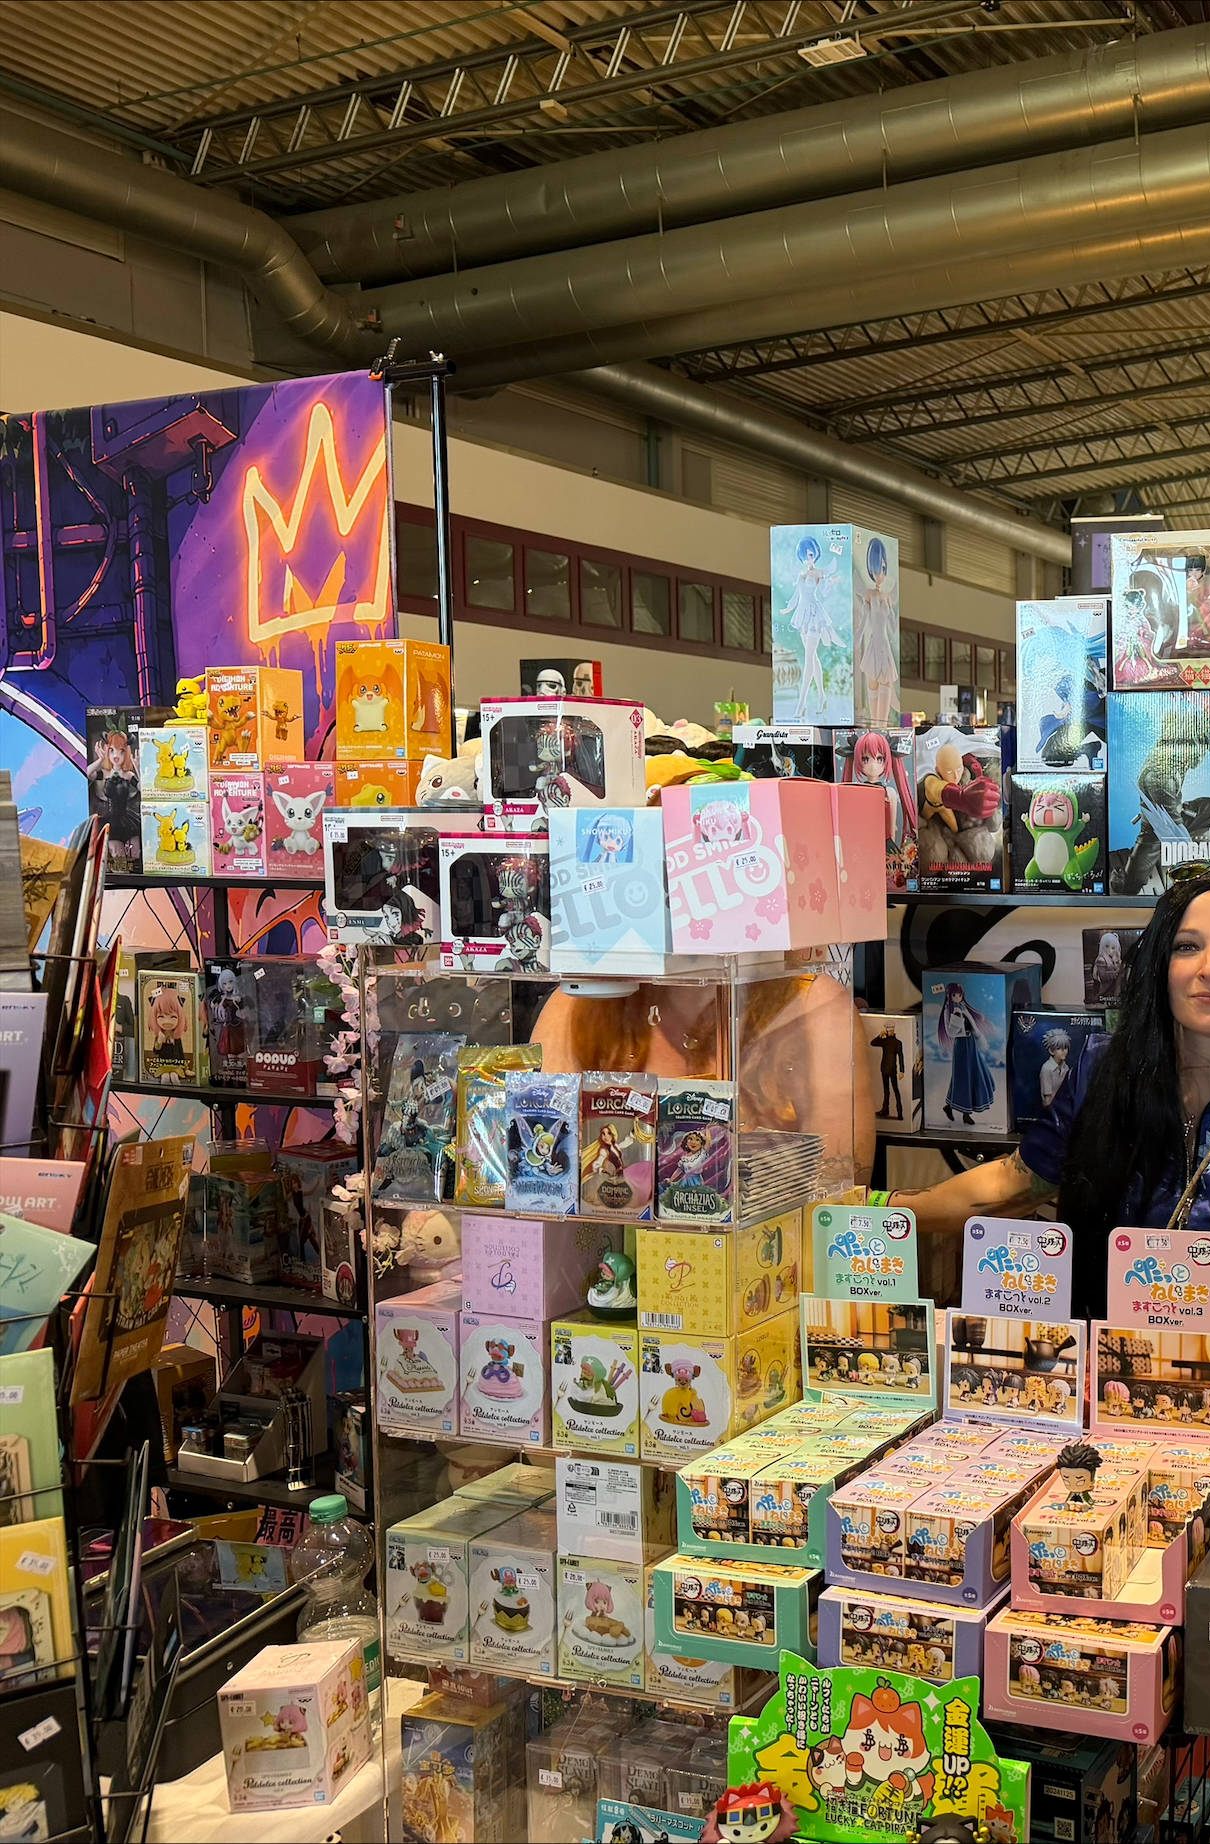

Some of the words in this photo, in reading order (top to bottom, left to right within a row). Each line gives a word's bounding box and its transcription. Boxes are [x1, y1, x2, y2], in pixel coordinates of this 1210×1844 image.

[412, 650, 445, 660] PATAMON
[631, 714, 642, 722] 03
[741, 855, 756, 865] 25.00
[589, 881, 603, 890] 25.00
[515, 1098, 552, 1109] LORCA
[591, 1098, 629, 1111] LORCA
[667, 1103, 703, 1116] LORC
[25, 1198, 57, 1208] ART
[673, 1191, 716, 1207] ARCHAZIAS
[858, 1219, 872, 1230] 7.50
[1016, 1236, 1031, 1246] 7.50
[1154, 1237, 1170, 1248] 7.50
[835, 1272, 875, 1285] ますこっと
[876, 1278, 896, 1287] vol.1
[849, 1286, 883, 1297] BOXver.
[984, 1287, 1027, 1303] ますこっと
[1028, 1295, 1051, 1305] vol.2
[998, 1303, 1033, 1315] BOXver.
[1131, 1300, 1177, 1314] ますこっと
[1179, 1306, 1204, 1317] vol.3
[1147, 1314, 1186, 1326] BOXver.
[473, 1406, 499, 1421] Paldolce
[501, 1412, 530, 1425] collection
[566, 1418, 592, 1432] Paldolce
[595, 1424, 625, 1437] collection
[654, 1428, 680, 1443] Paldolce
[682, 1435, 715, 1447] collection
[433, 1551, 447, 1559] 25.00
[523, 1578, 537, 1586] 25.00
[399, 1622, 423, 1636] Paldolce
[425, 1628, 455, 1642] collection
[483, 1636, 510, 1650] Paldolce
[512, 1641, 541, 1656] collection
[572, 1645, 597, 1660] Paldolce
[599, 1652, 631, 1665] collection
[659, 1665, 686, 1680] Paldolce
[688, 1672, 720, 1686] collection
[278, 1777, 312, 1787] collection
[547, 1776, 560, 1784] 15.00
[826, 1813, 856, 1827] LUCKY
